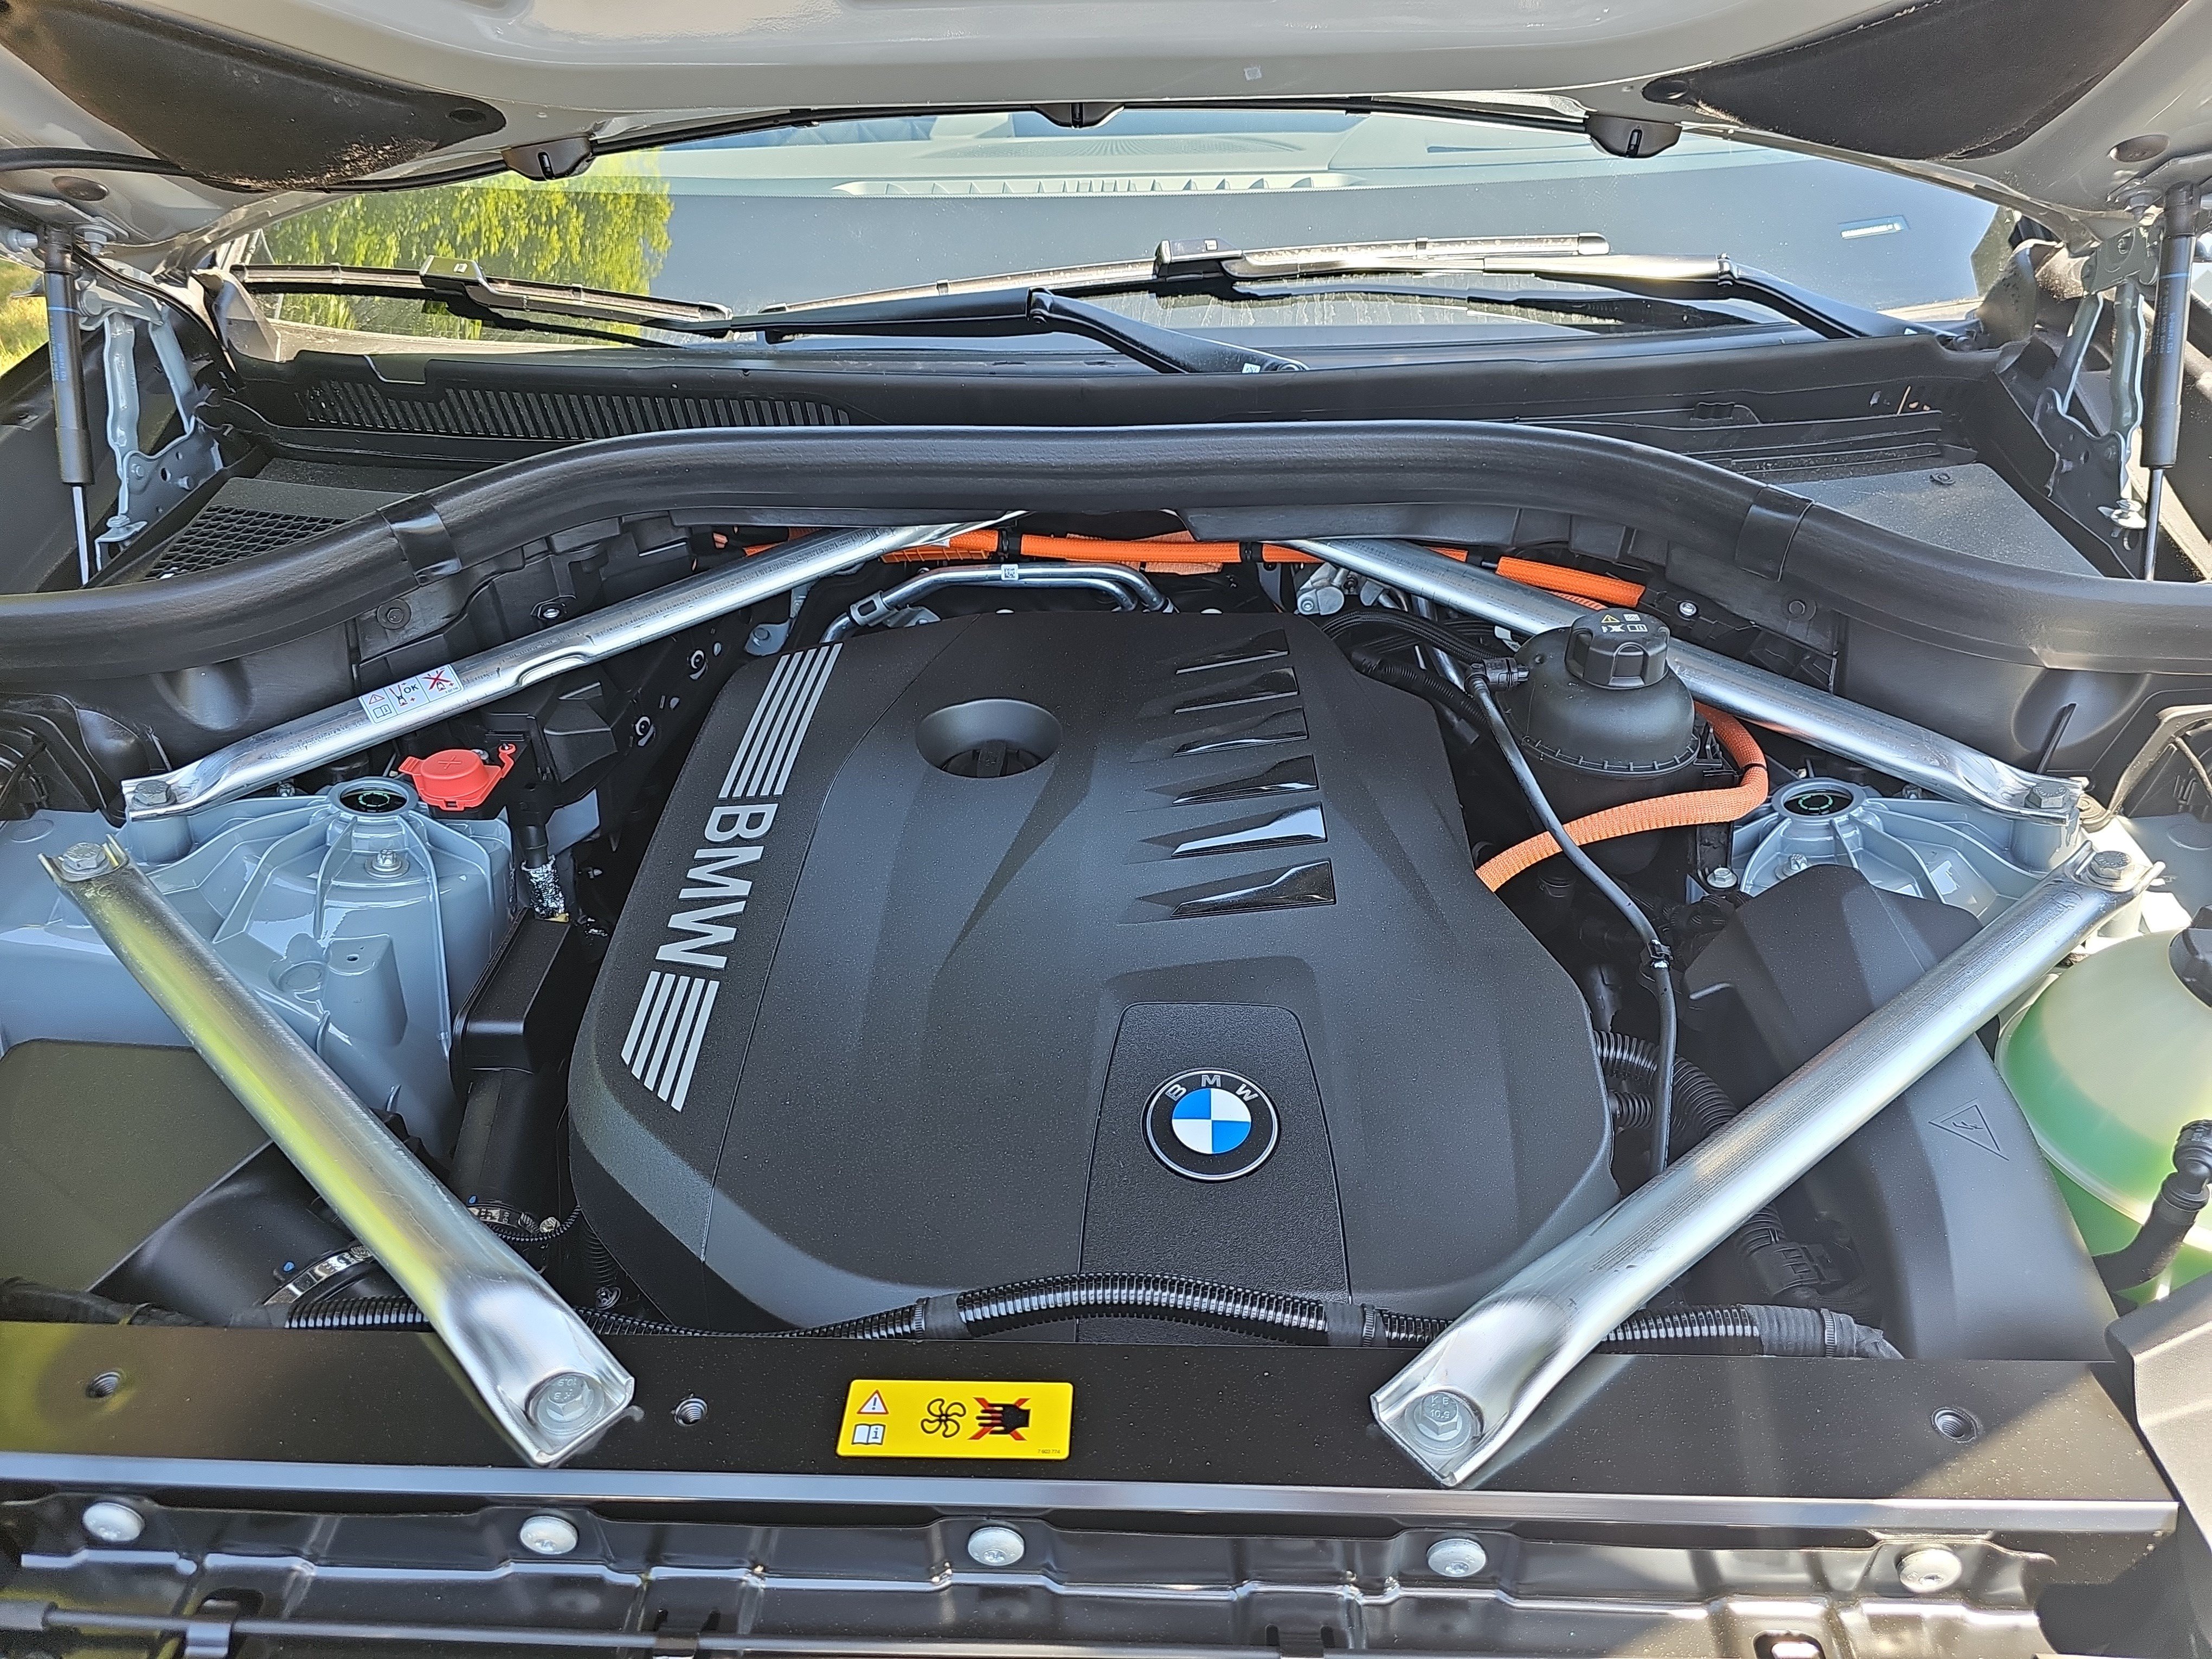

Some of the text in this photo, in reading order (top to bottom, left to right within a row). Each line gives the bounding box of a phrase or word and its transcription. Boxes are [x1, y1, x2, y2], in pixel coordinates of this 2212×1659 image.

[404, 684, 419, 693] OK
[655, 803, 779, 969] BMW
[1165, 1075, 1258, 1102] BMW
[1430, 1409, 1450, 1419] 10.9
